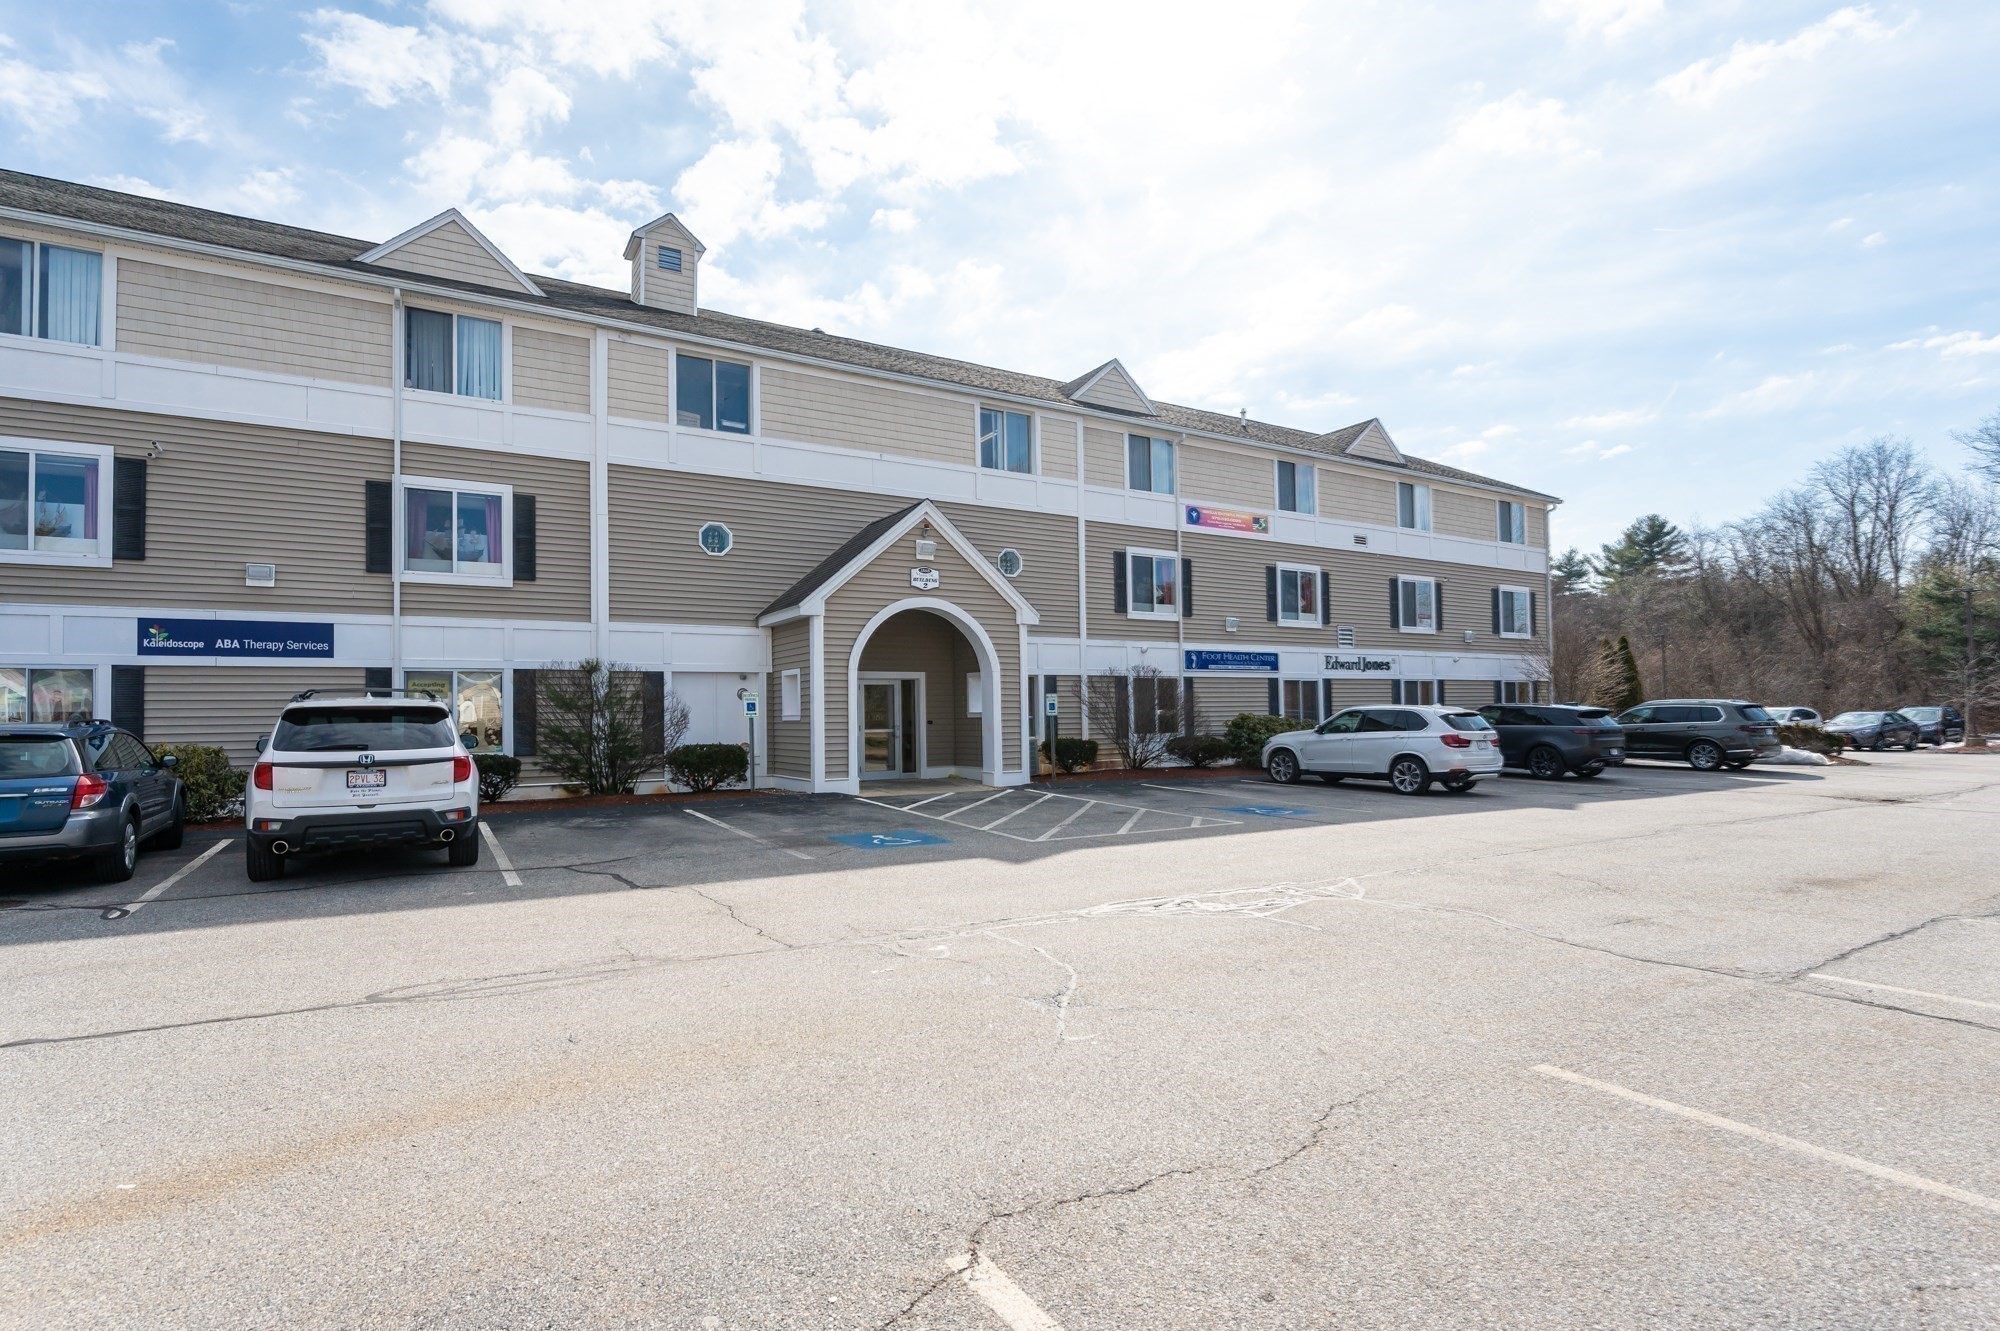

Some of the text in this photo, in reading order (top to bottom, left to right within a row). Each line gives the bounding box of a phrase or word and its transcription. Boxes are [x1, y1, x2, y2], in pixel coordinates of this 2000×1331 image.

[143, 638, 329, 652] Kaleidoscope ABA Therapy Services
[350, 774, 384, 784] 2PVL 32
